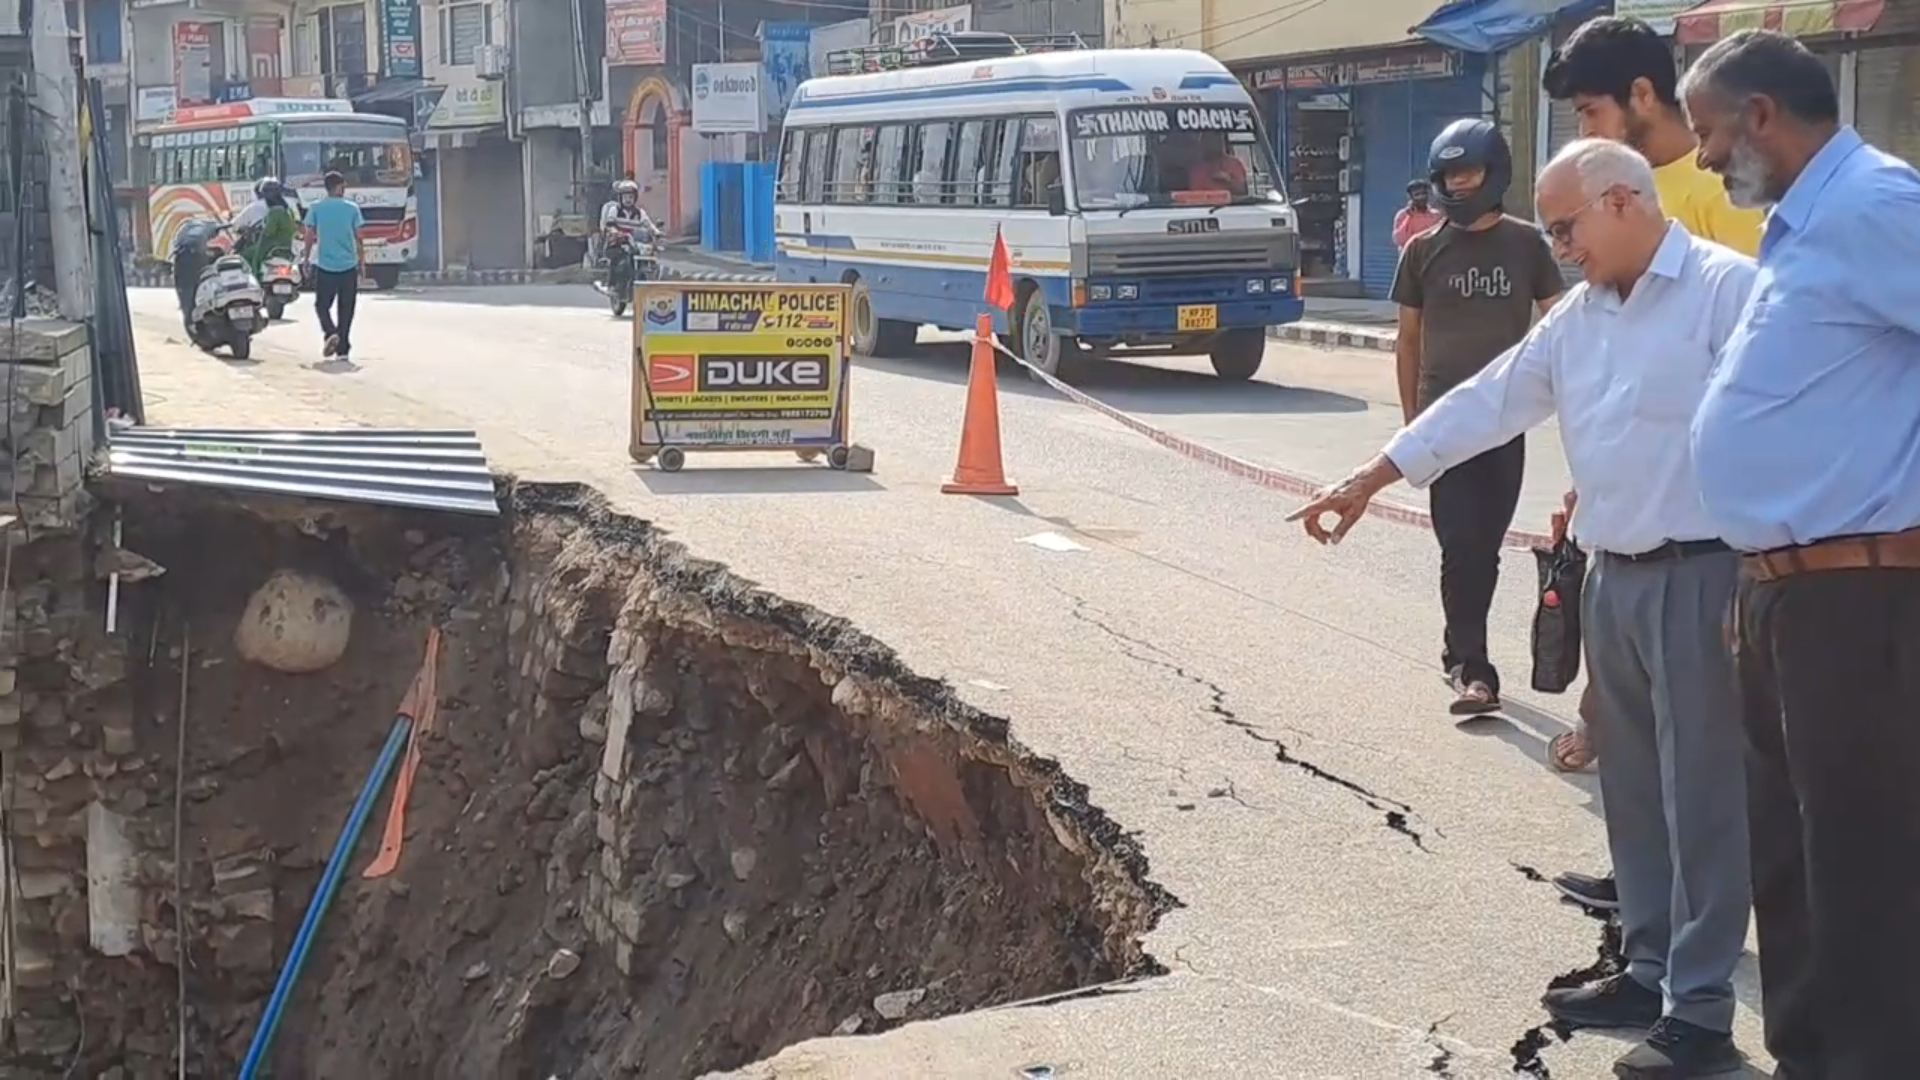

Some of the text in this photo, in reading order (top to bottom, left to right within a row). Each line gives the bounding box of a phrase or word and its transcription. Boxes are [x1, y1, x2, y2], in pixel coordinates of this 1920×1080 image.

[1097, 108, 1231, 134] THAKUR COACH
[688, 293, 835, 312] HIMACHAL POLICE
[776, 313, 803, 329] 112
[707, 361, 820, 385] DUKE
